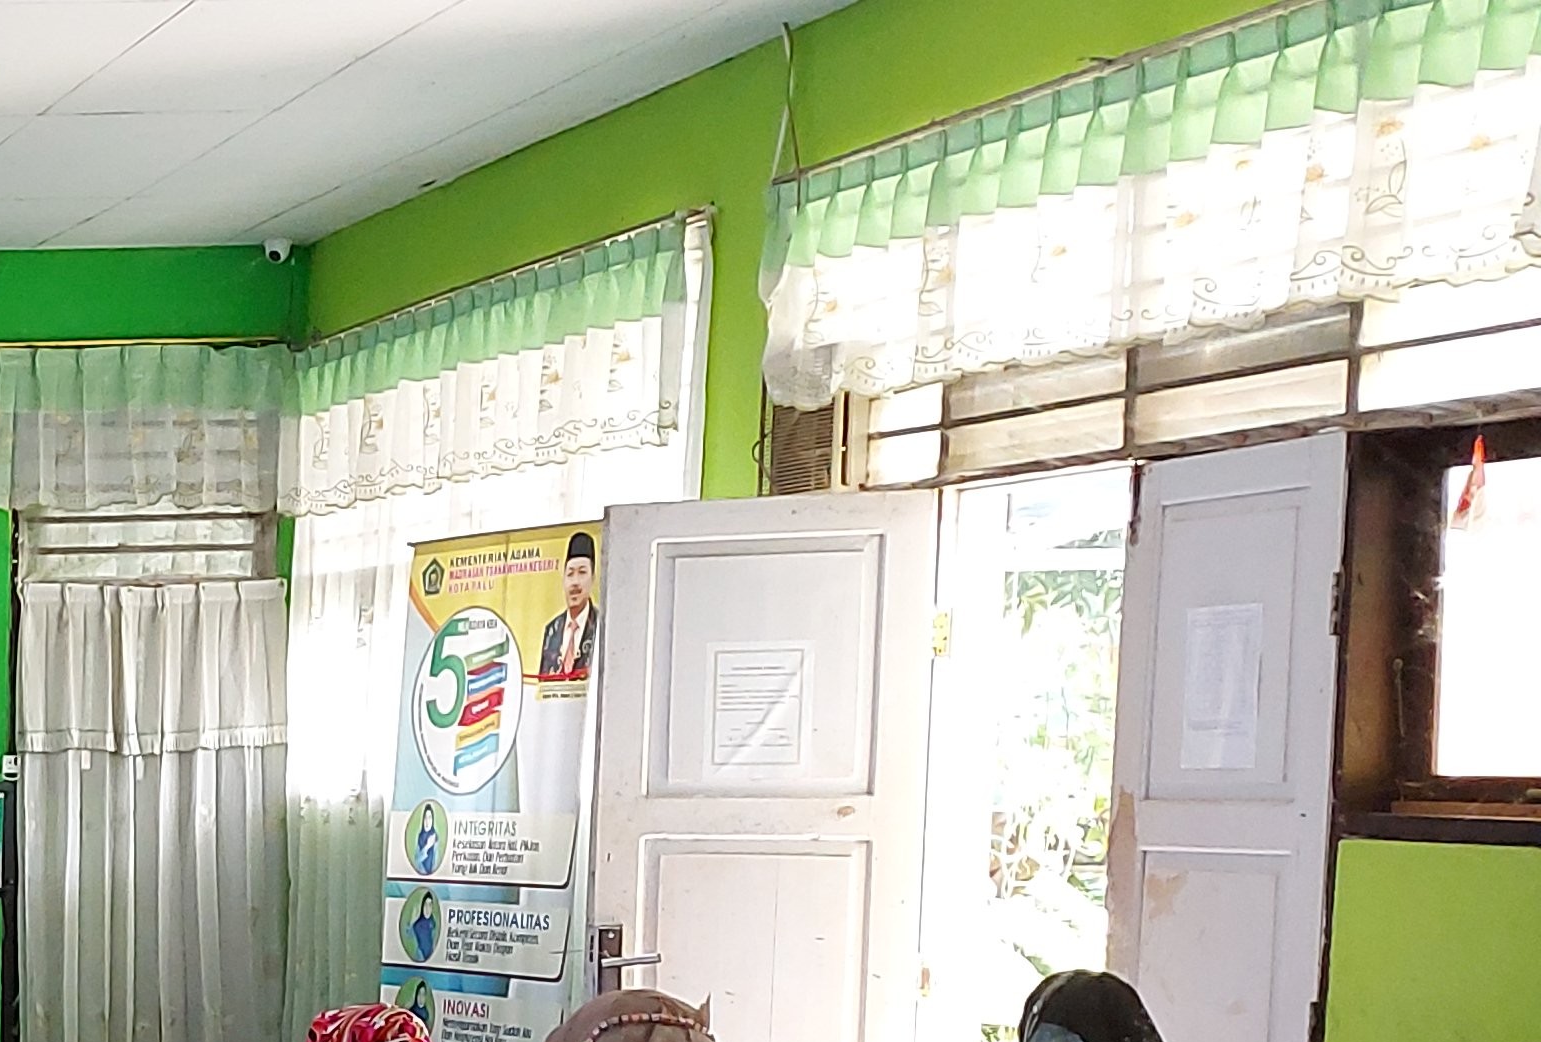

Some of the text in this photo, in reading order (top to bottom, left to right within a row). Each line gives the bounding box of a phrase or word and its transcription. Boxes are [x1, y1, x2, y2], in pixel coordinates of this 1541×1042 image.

[454, 820, 517, 836] INTEGRITAS
[448, 908, 549, 930] PROFESIONALITAS
[443, 999, 489, 1019] INOVASI
